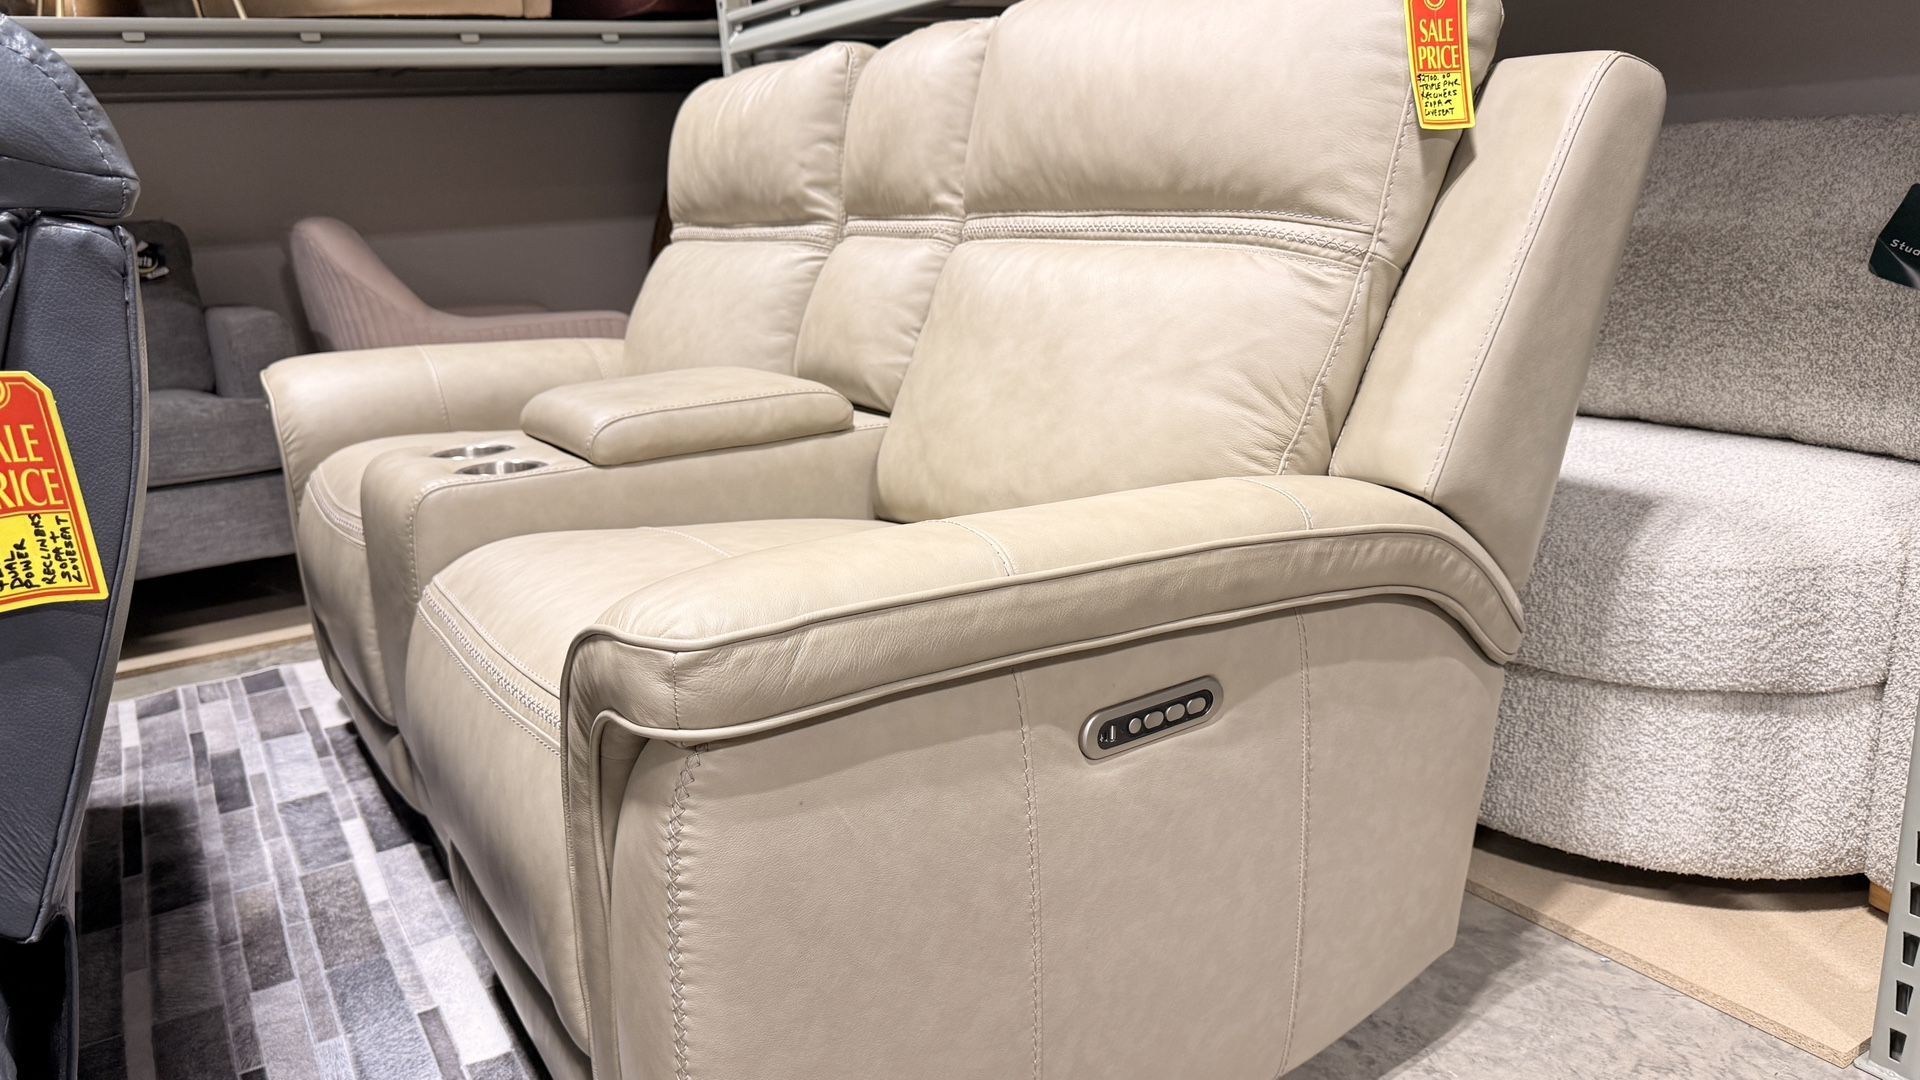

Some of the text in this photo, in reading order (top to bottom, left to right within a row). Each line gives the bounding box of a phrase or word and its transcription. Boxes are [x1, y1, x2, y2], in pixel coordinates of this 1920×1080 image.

[1419, 18, 1454, 43] SALE
[1417, 45, 1460, 69] PRICE
[4, 550, 24, 589] DUAL
[13, 538, 41, 589] POWER
